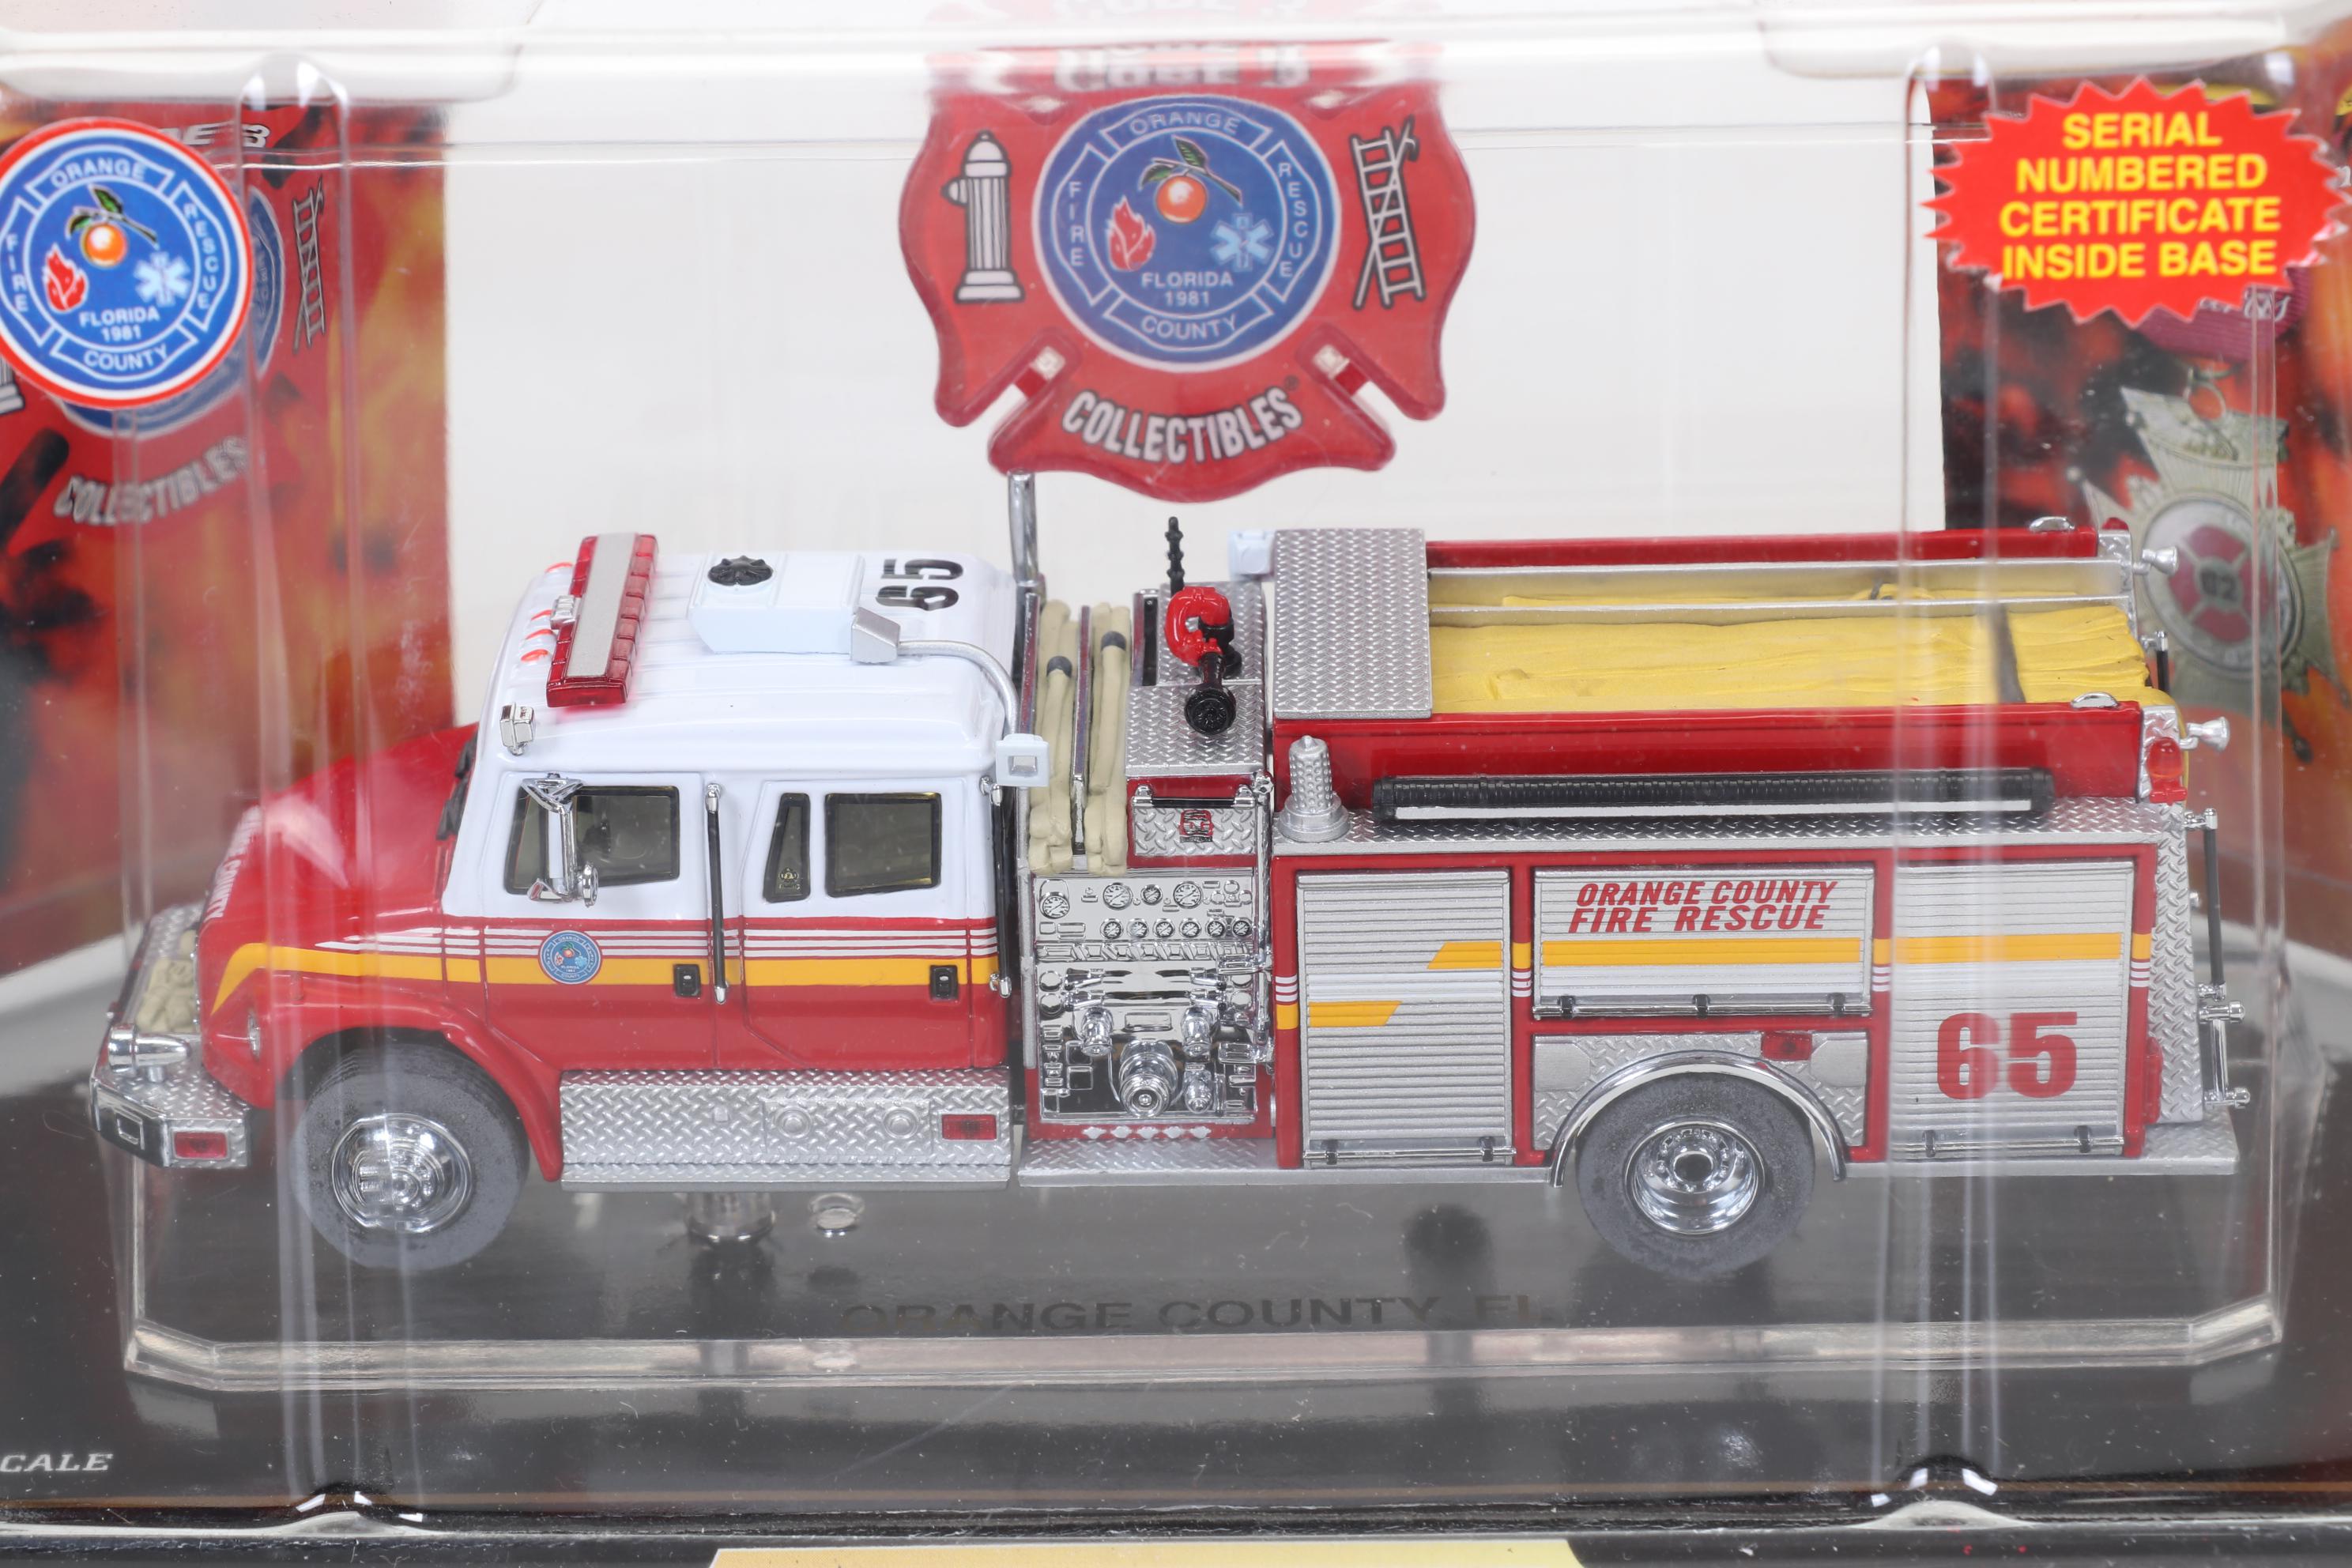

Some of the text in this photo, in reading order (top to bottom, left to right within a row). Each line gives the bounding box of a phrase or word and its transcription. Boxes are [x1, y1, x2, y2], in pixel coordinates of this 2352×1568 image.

[1129, 111, 1242, 136] ORANGE
[2063, 111, 2222, 149] SERIAL
[51, 157, 146, 188] ORANGE
[2017, 153, 2268, 194] NUMBERED
[1069, 181, 1085, 266] FIRE
[1278, 161, 1309, 277] RESCUE
[1999, 195, 2282, 238] CERTIFICATE
[183, 202, 219, 309] RESCUE
[2002, 239, 2278, 280] INSIDE BASE
[6, 234, 28, 312] FIRE
[1141, 271, 1234, 288] FLORIDA
[1164, 291, 1211, 307] 1981
[79, 306, 160, 327] FLORIDA
[1140, 315, 1238, 341] COUNTY
[101, 326, 141, 342] 1981
[84, 343, 168, 371] COUNTY
[1061, 386, 1303, 465] COLLECTIBLES
[1577, 879, 1838, 906] ORANGE COUNTY
[1568, 904, 1831, 933] FIRE RESCUE
[1937, 1011, 2078, 1100] 65
[840, 1302, 1133, 1332] ORANGE
